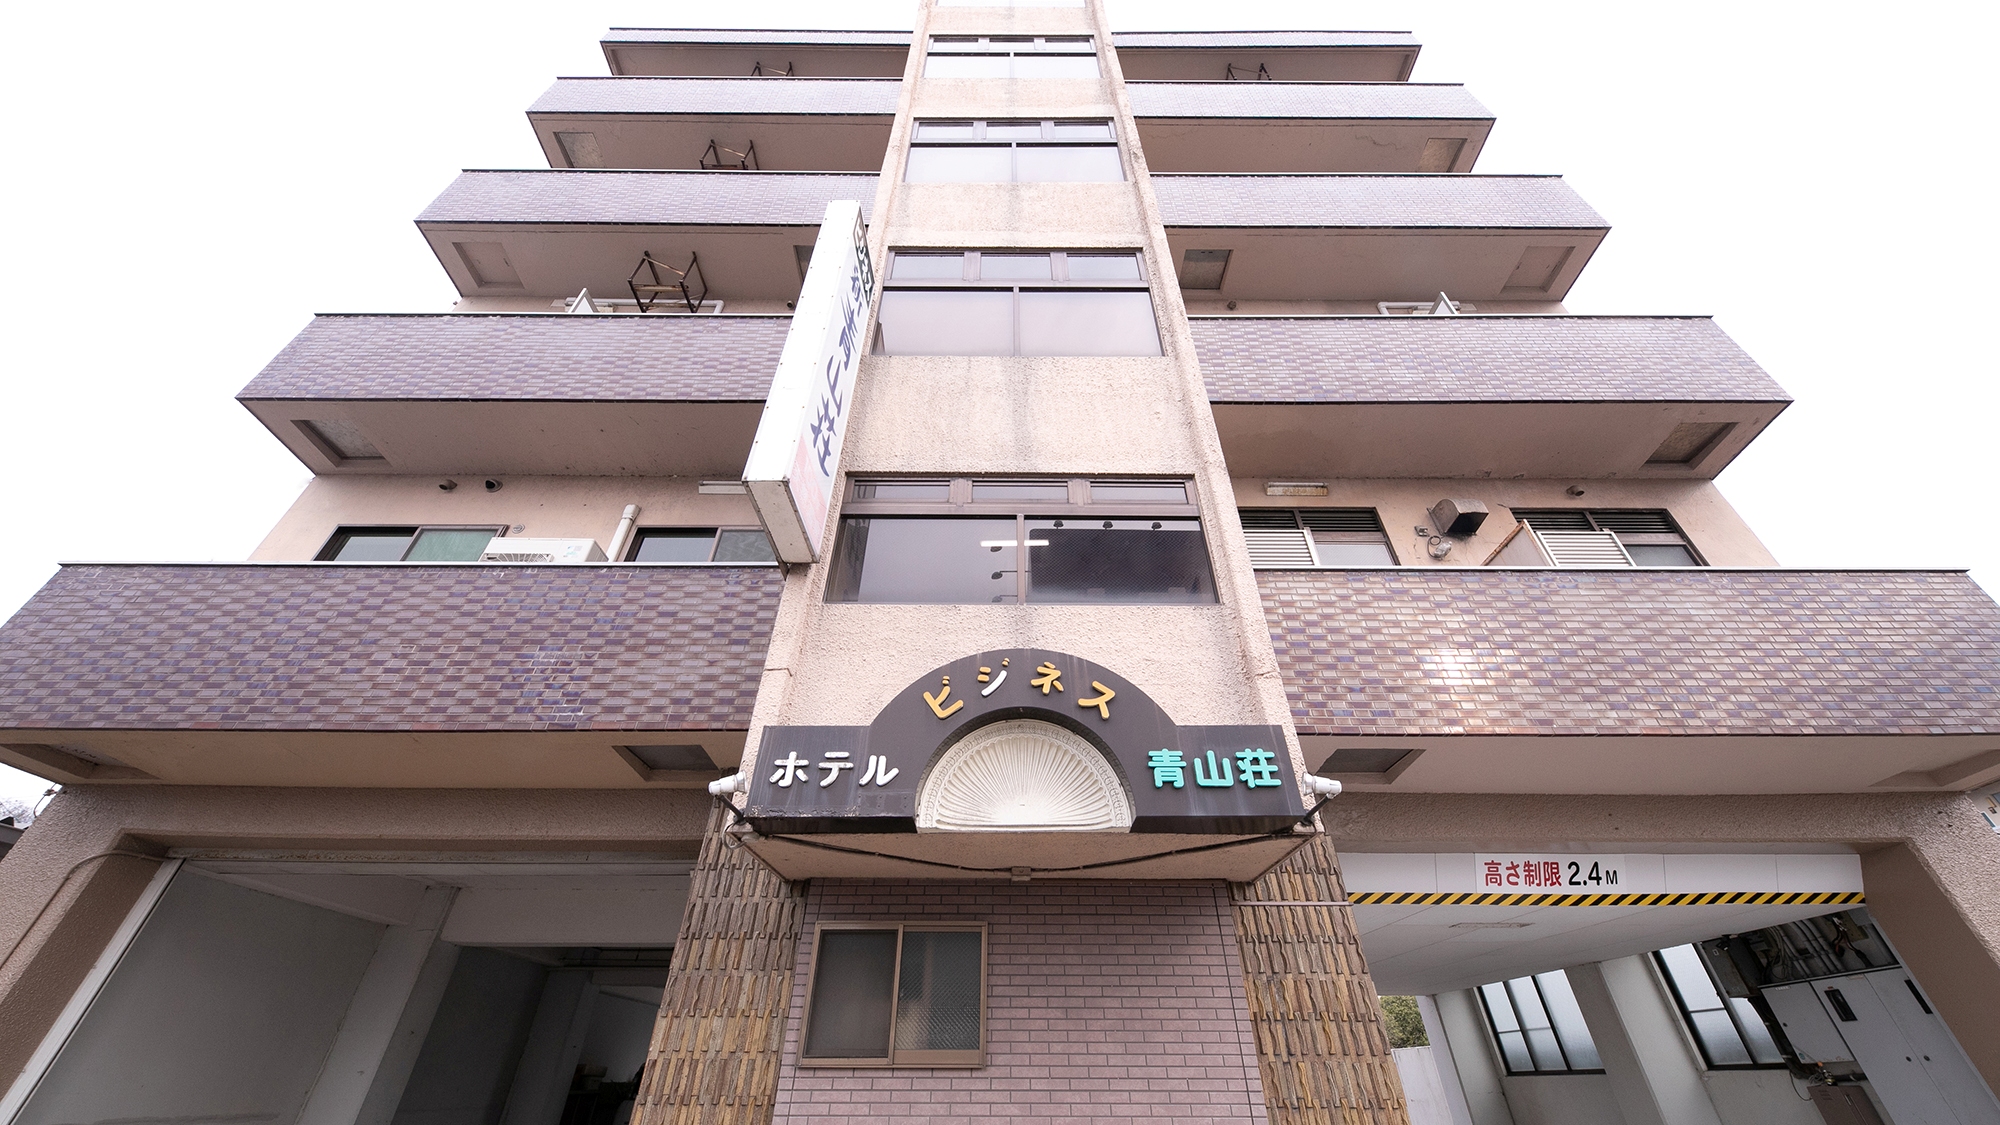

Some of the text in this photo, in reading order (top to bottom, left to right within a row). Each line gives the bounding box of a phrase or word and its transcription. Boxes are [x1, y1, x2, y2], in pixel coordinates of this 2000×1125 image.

[922, 657, 1117, 720] ビジネス
[769, 748, 1283, 790] ホテル 青山荘
[1484, 860, 1562, 887] 高さ制限
